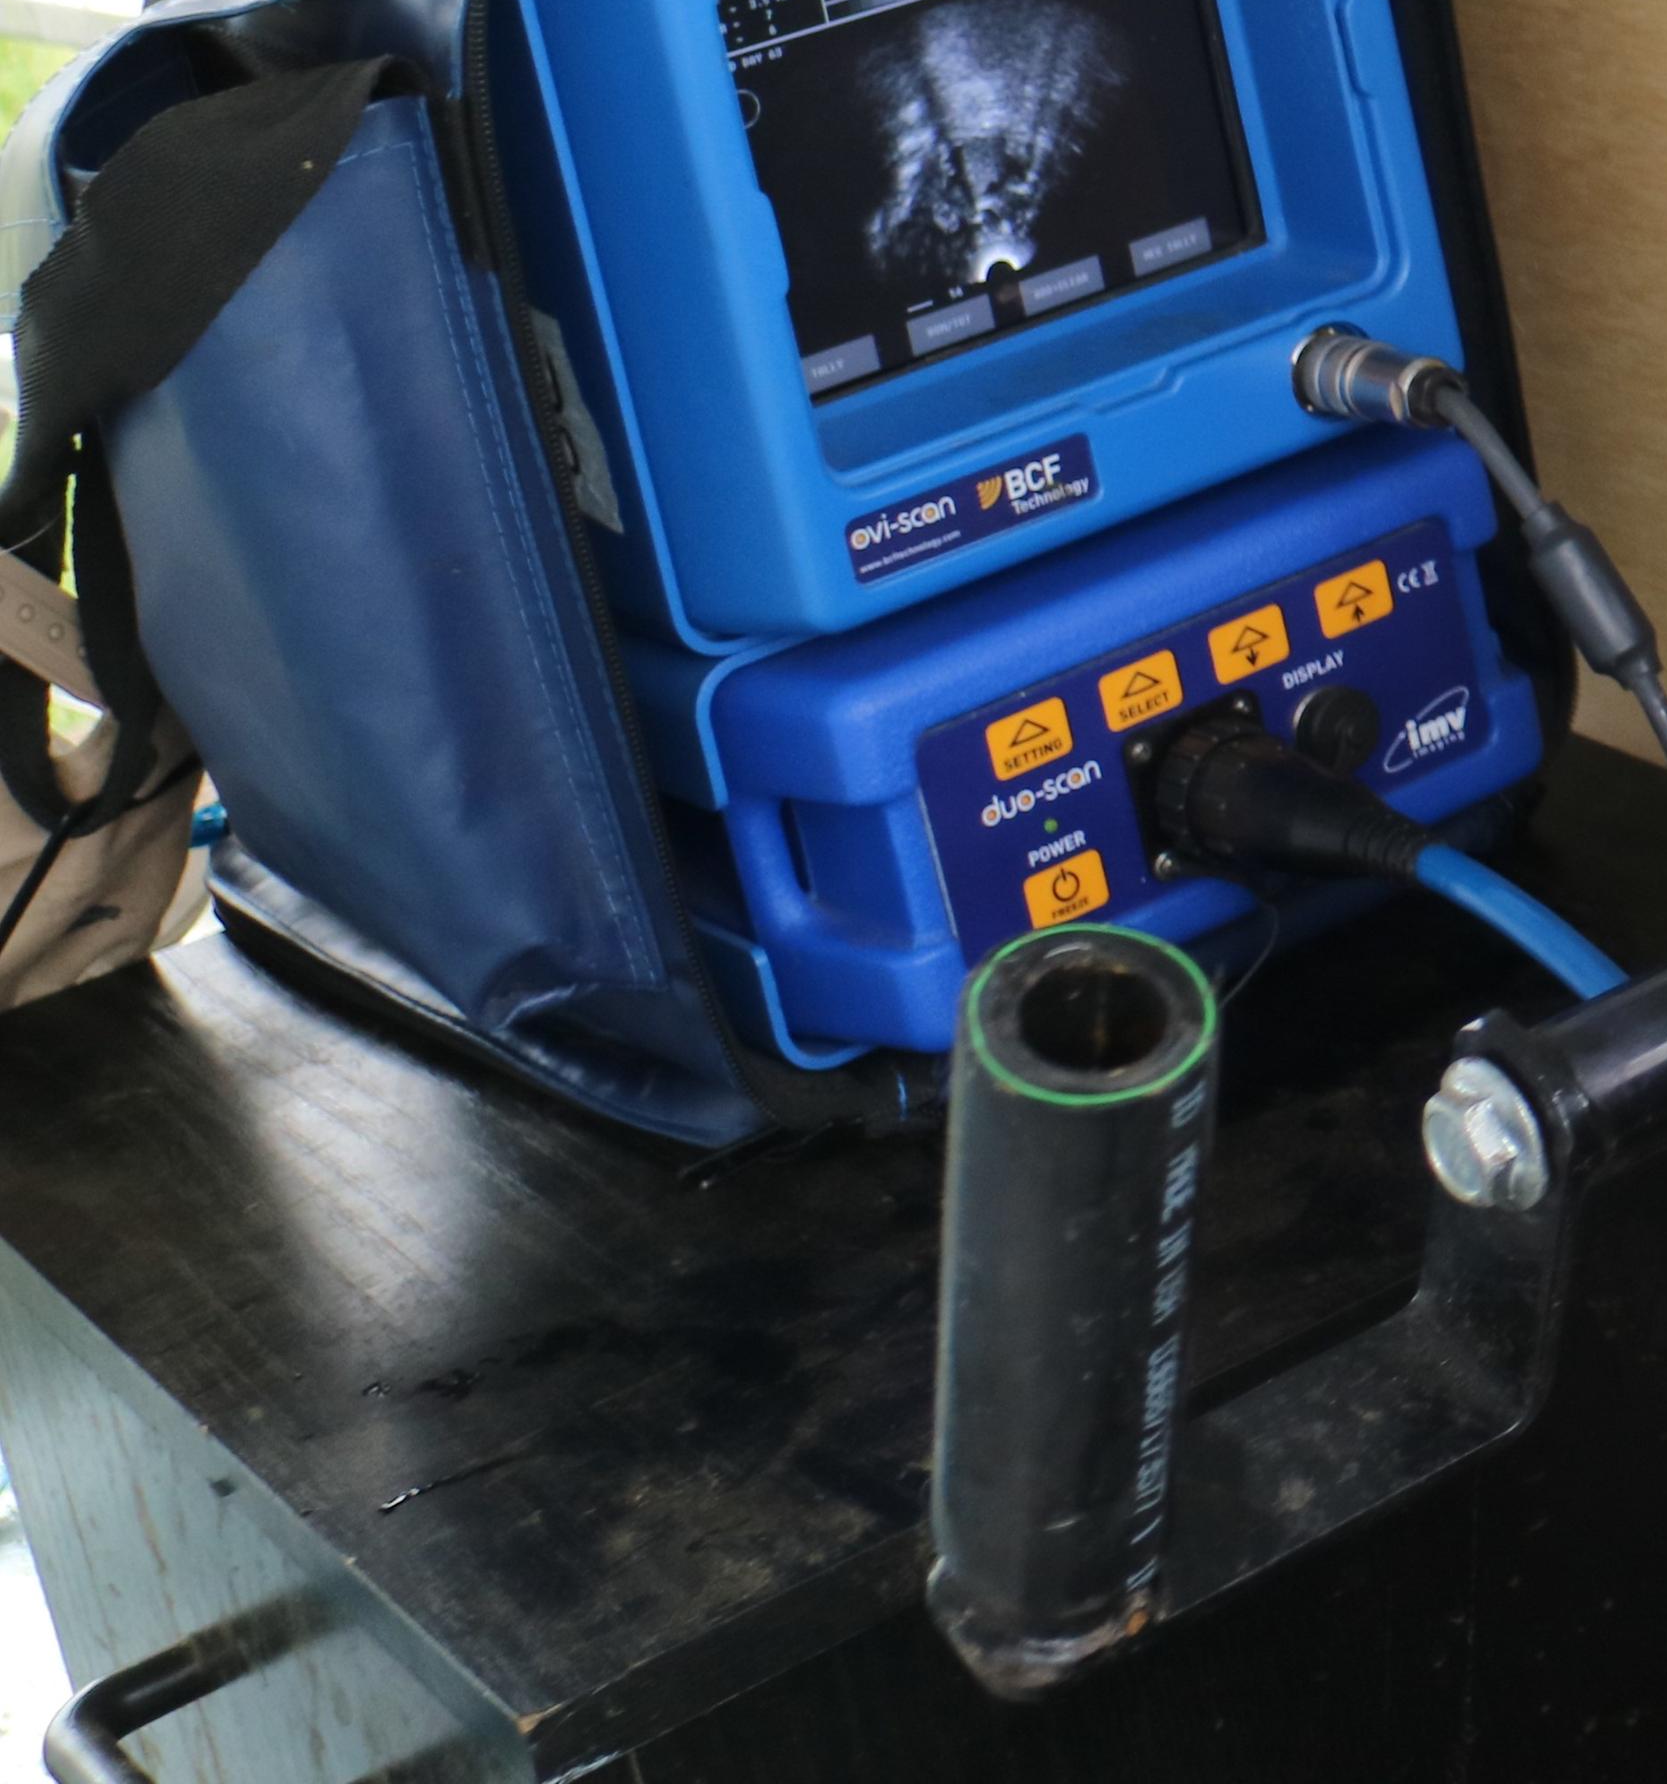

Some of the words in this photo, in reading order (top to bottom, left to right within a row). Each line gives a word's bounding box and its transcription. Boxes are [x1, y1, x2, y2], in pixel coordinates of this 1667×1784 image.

[1003, 452, 1061, 501] BCF
[1010, 476, 1090, 516] Technology
[850, 495, 957, 551] ovi-scan
[1282, 649, 1345, 691] DISPLAY
[1118, 690, 1170, 722] SELECT
[1405, 705, 1467, 752] imv
[1003, 737, 1064, 774] SETTING
[981, 759, 1103, 828] duo-scan
[1027, 829, 1087, 868] POWER
